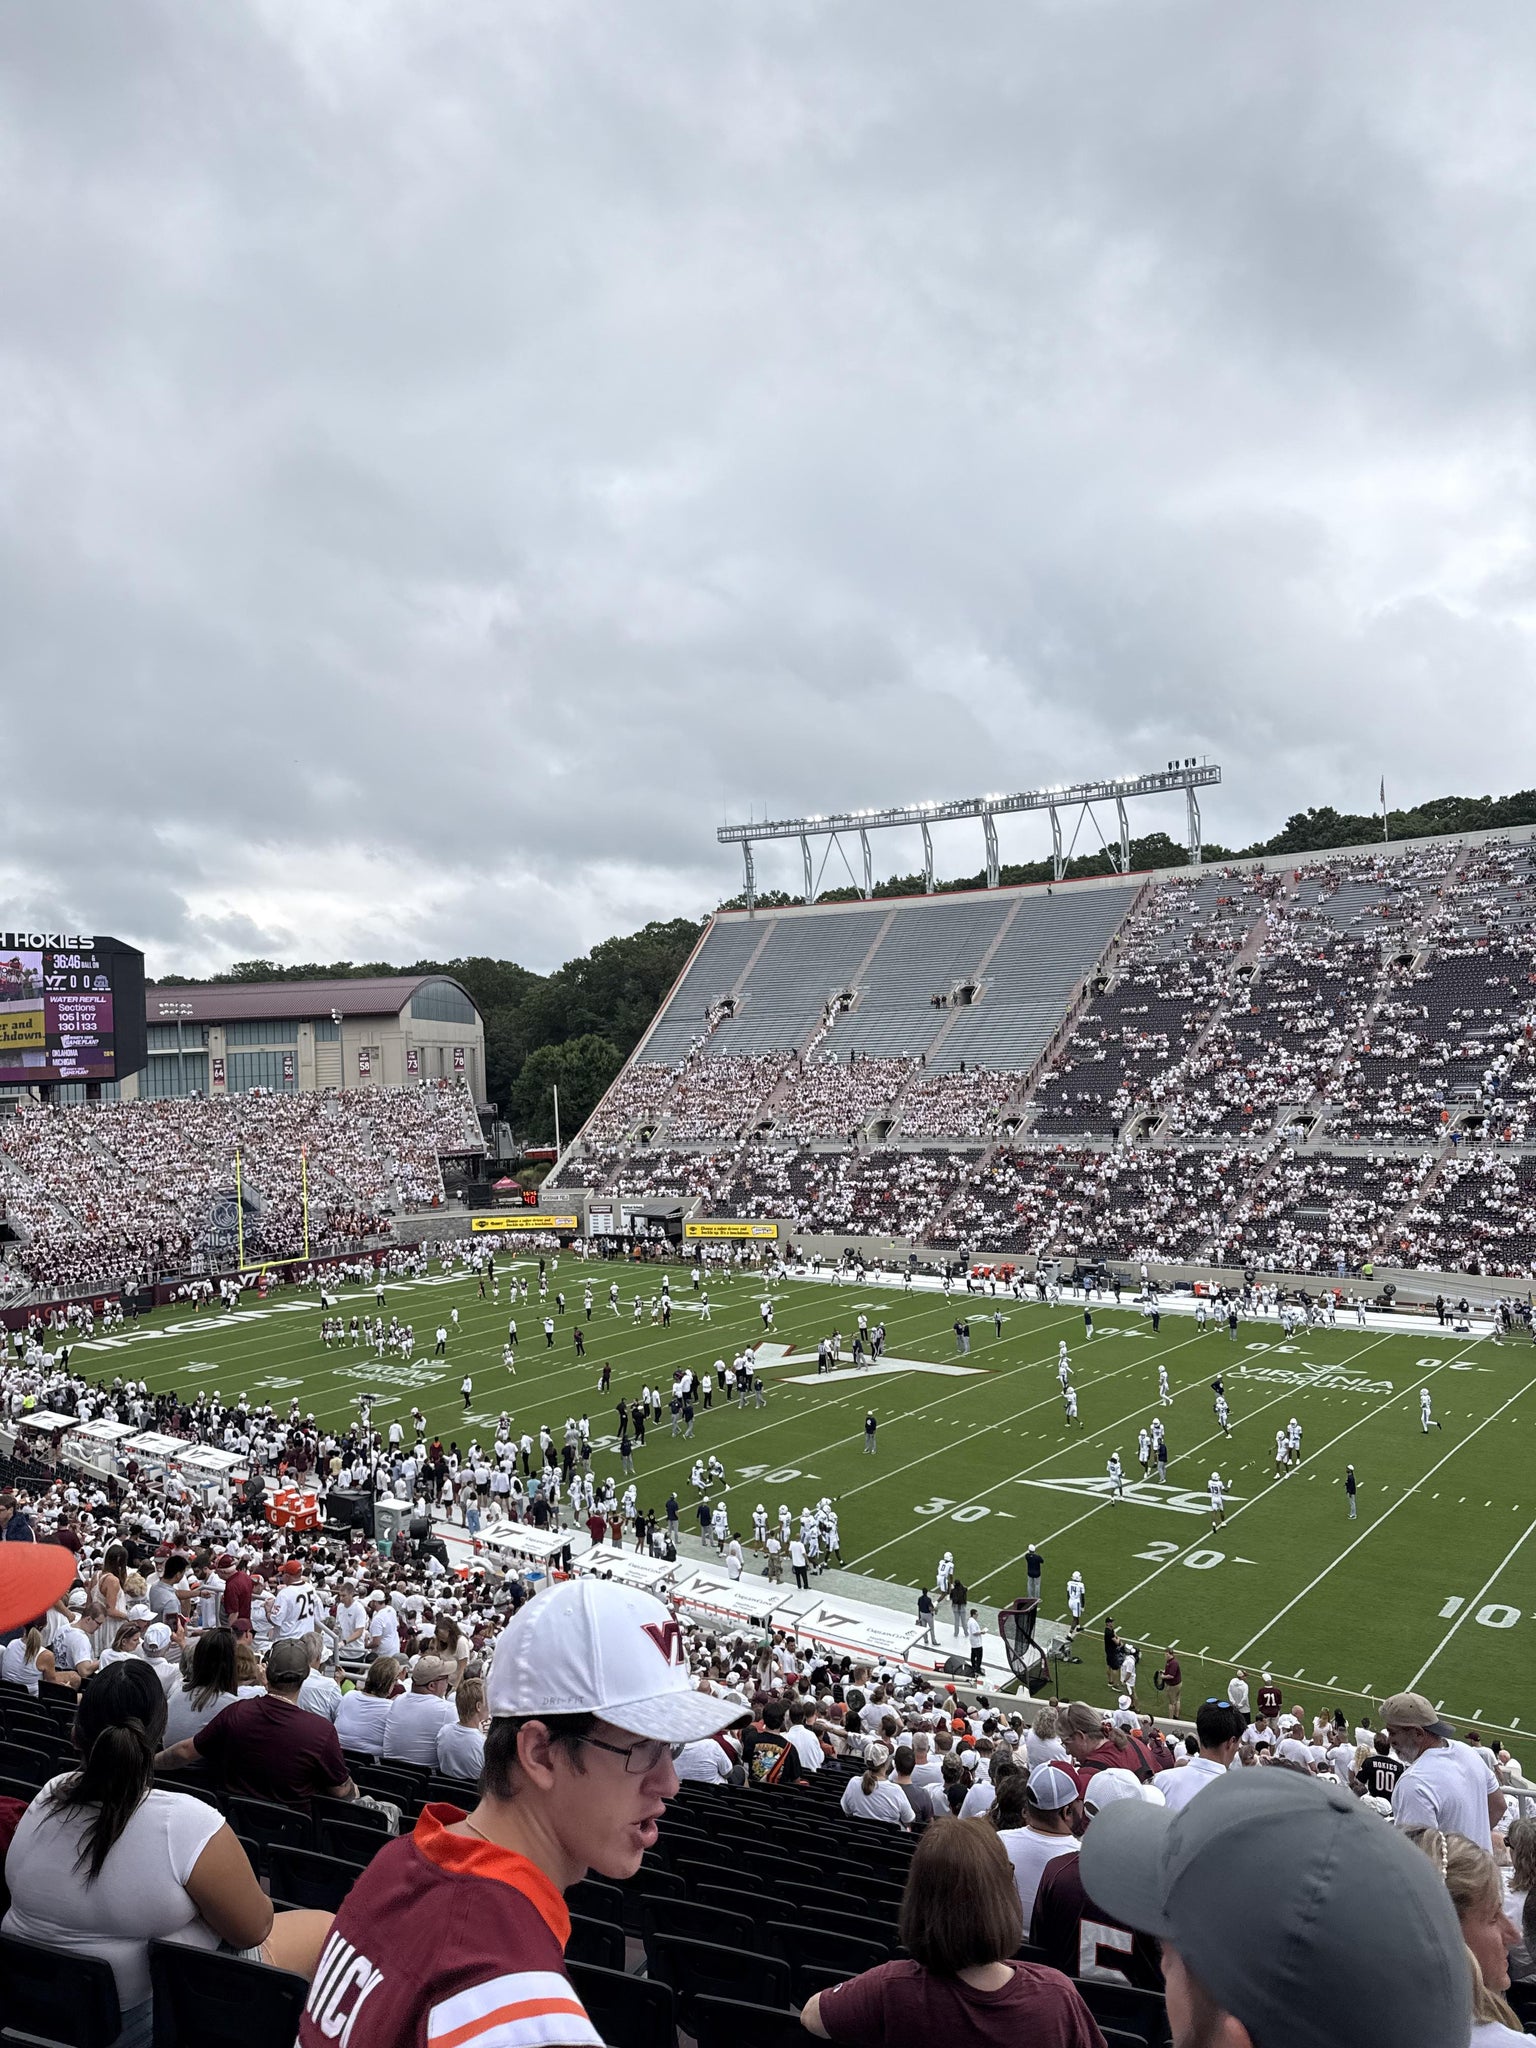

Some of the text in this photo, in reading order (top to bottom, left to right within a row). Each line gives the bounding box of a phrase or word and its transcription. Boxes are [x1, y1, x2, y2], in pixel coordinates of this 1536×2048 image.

[14, 932, 95, 950] HOKIES
[53, 954, 80, 969] 36:46
[44, 975, 67, 988] VT
[58, 1004, 96, 1012] Sections
[58, 1013, 96, 1021] 105 107
[12, 1018, 33, 1030] and
[58, 1023, 98, 1031] 130 133
[52, 1058, 76, 1066] MICHIGAN
[360, 1062, 370, 1070] 58
[408, 1060, 418, 1069] 73
[454, 1057, 464, 1066] 78
[214, 1069, 224, 1078] 64
[284, 1066, 292, 1075] 56
[524, 1196, 536, 1204] 40
[203, 1228, 252, 1246] Allstae
[239, 1272, 261, 1286] VT
[1415, 1358, 1478, 1370] 20
[353, 1362, 446, 1382] VIRGINIA
[1240, 1366, 1394, 1389] VIRGINIA
[1226, 1372, 1392, 1394] Credit Union
[735, 1464, 802, 1484] 40
[270, 1510, 277, 1522] G
[913, 1497, 991, 1522] 30
[305, 1516, 312, 1525] G
[490, 1526, 526, 1538] VT
[590, 1550, 628, 1564] VT
[1132, 1541, 1226, 1570] 20
[692, 1578, 732, 1594] VT
[296, 1590, 315, 1620] 25
[1438, 1596, 1521, 1628] 10
[818, 1610, 862, 1628] VT
[542, 1695, 585, 1706] DRI-FIT
[1264, 1693, 1276, 1706] 71
[1372, 1760, 1398, 1772] HOKIES
[1375, 1770, 1395, 1792] 00
